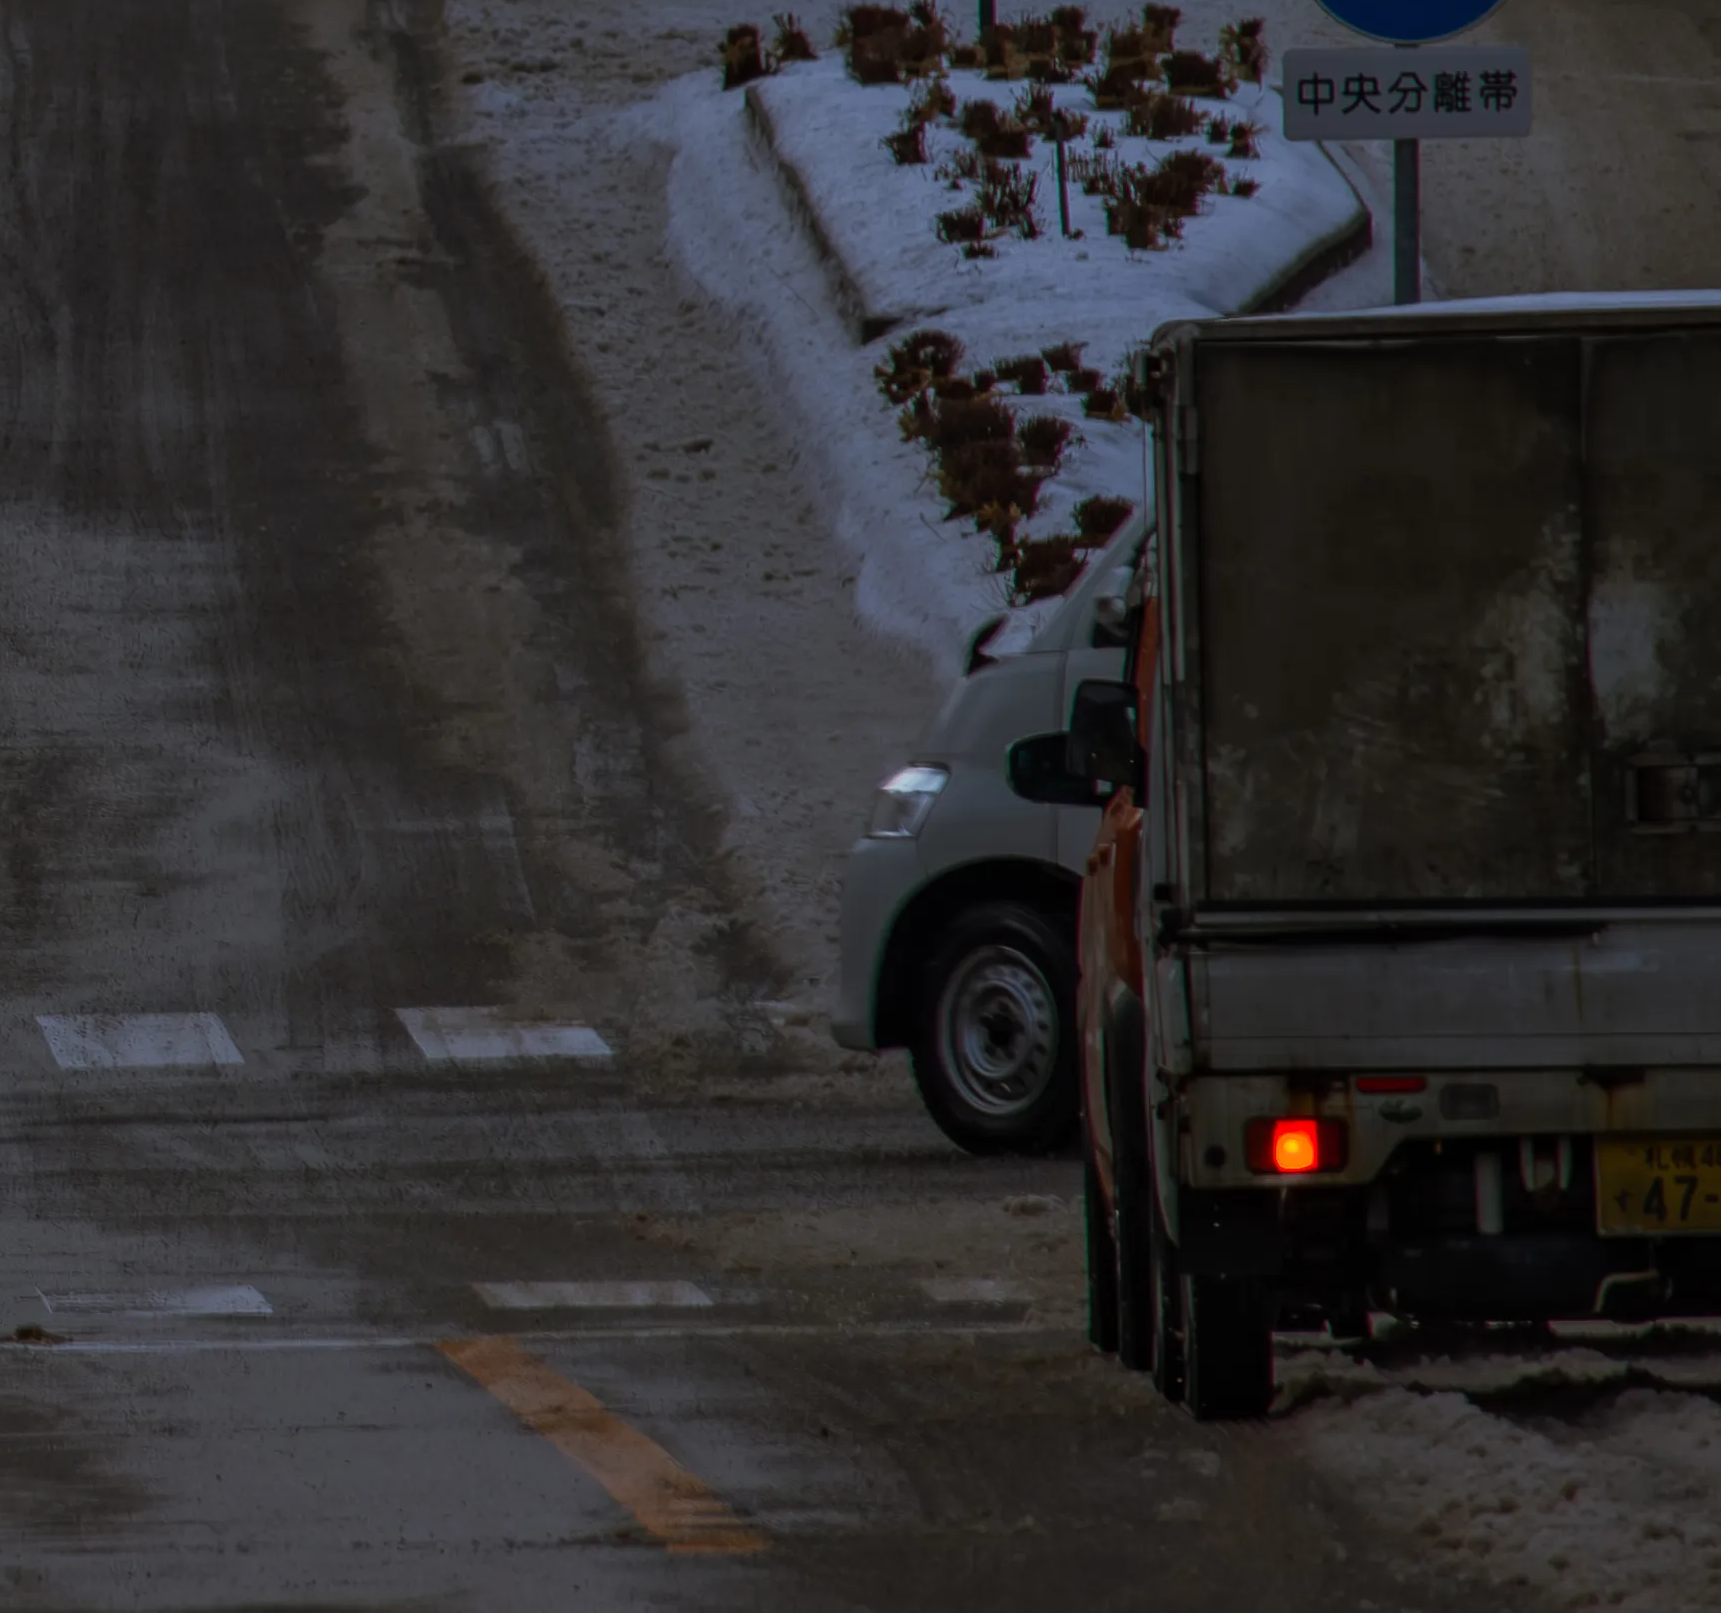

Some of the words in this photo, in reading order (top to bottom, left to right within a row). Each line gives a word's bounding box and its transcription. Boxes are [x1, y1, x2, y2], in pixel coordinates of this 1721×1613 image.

[1298, 71, 1518, 116] 中央分離帯
